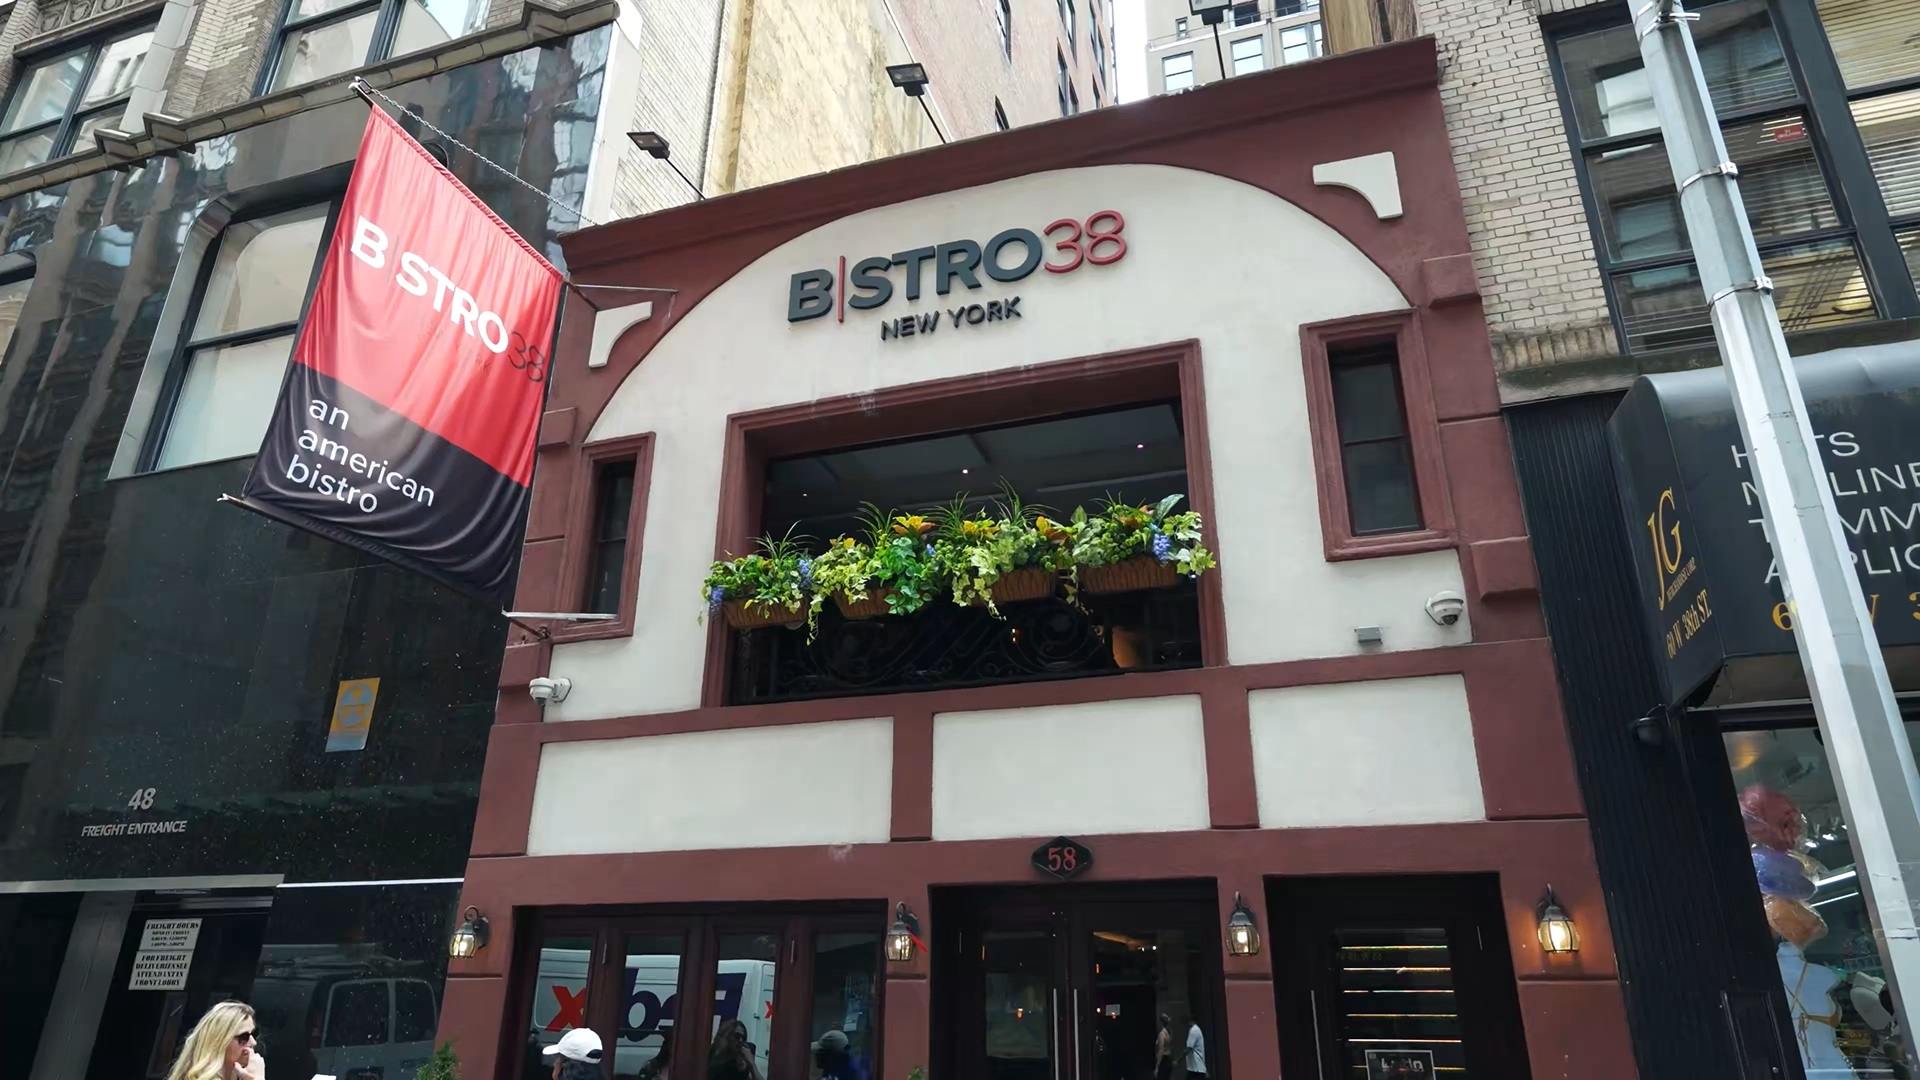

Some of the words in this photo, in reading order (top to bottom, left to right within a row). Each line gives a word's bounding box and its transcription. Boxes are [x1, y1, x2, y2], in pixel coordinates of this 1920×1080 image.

[880, 310, 940, 341] NEW
[947, 296, 1022, 329] YORK
[309, 399, 349, 430] an
[286, 454, 377, 513] bistro
[298, 429, 434, 507] american
[128, 787, 156, 810] 48
[81, 823, 127, 837] FREIGHT
[127, 820, 188, 834] ENTRANCE
[1048, 846, 1077, 871] 58
